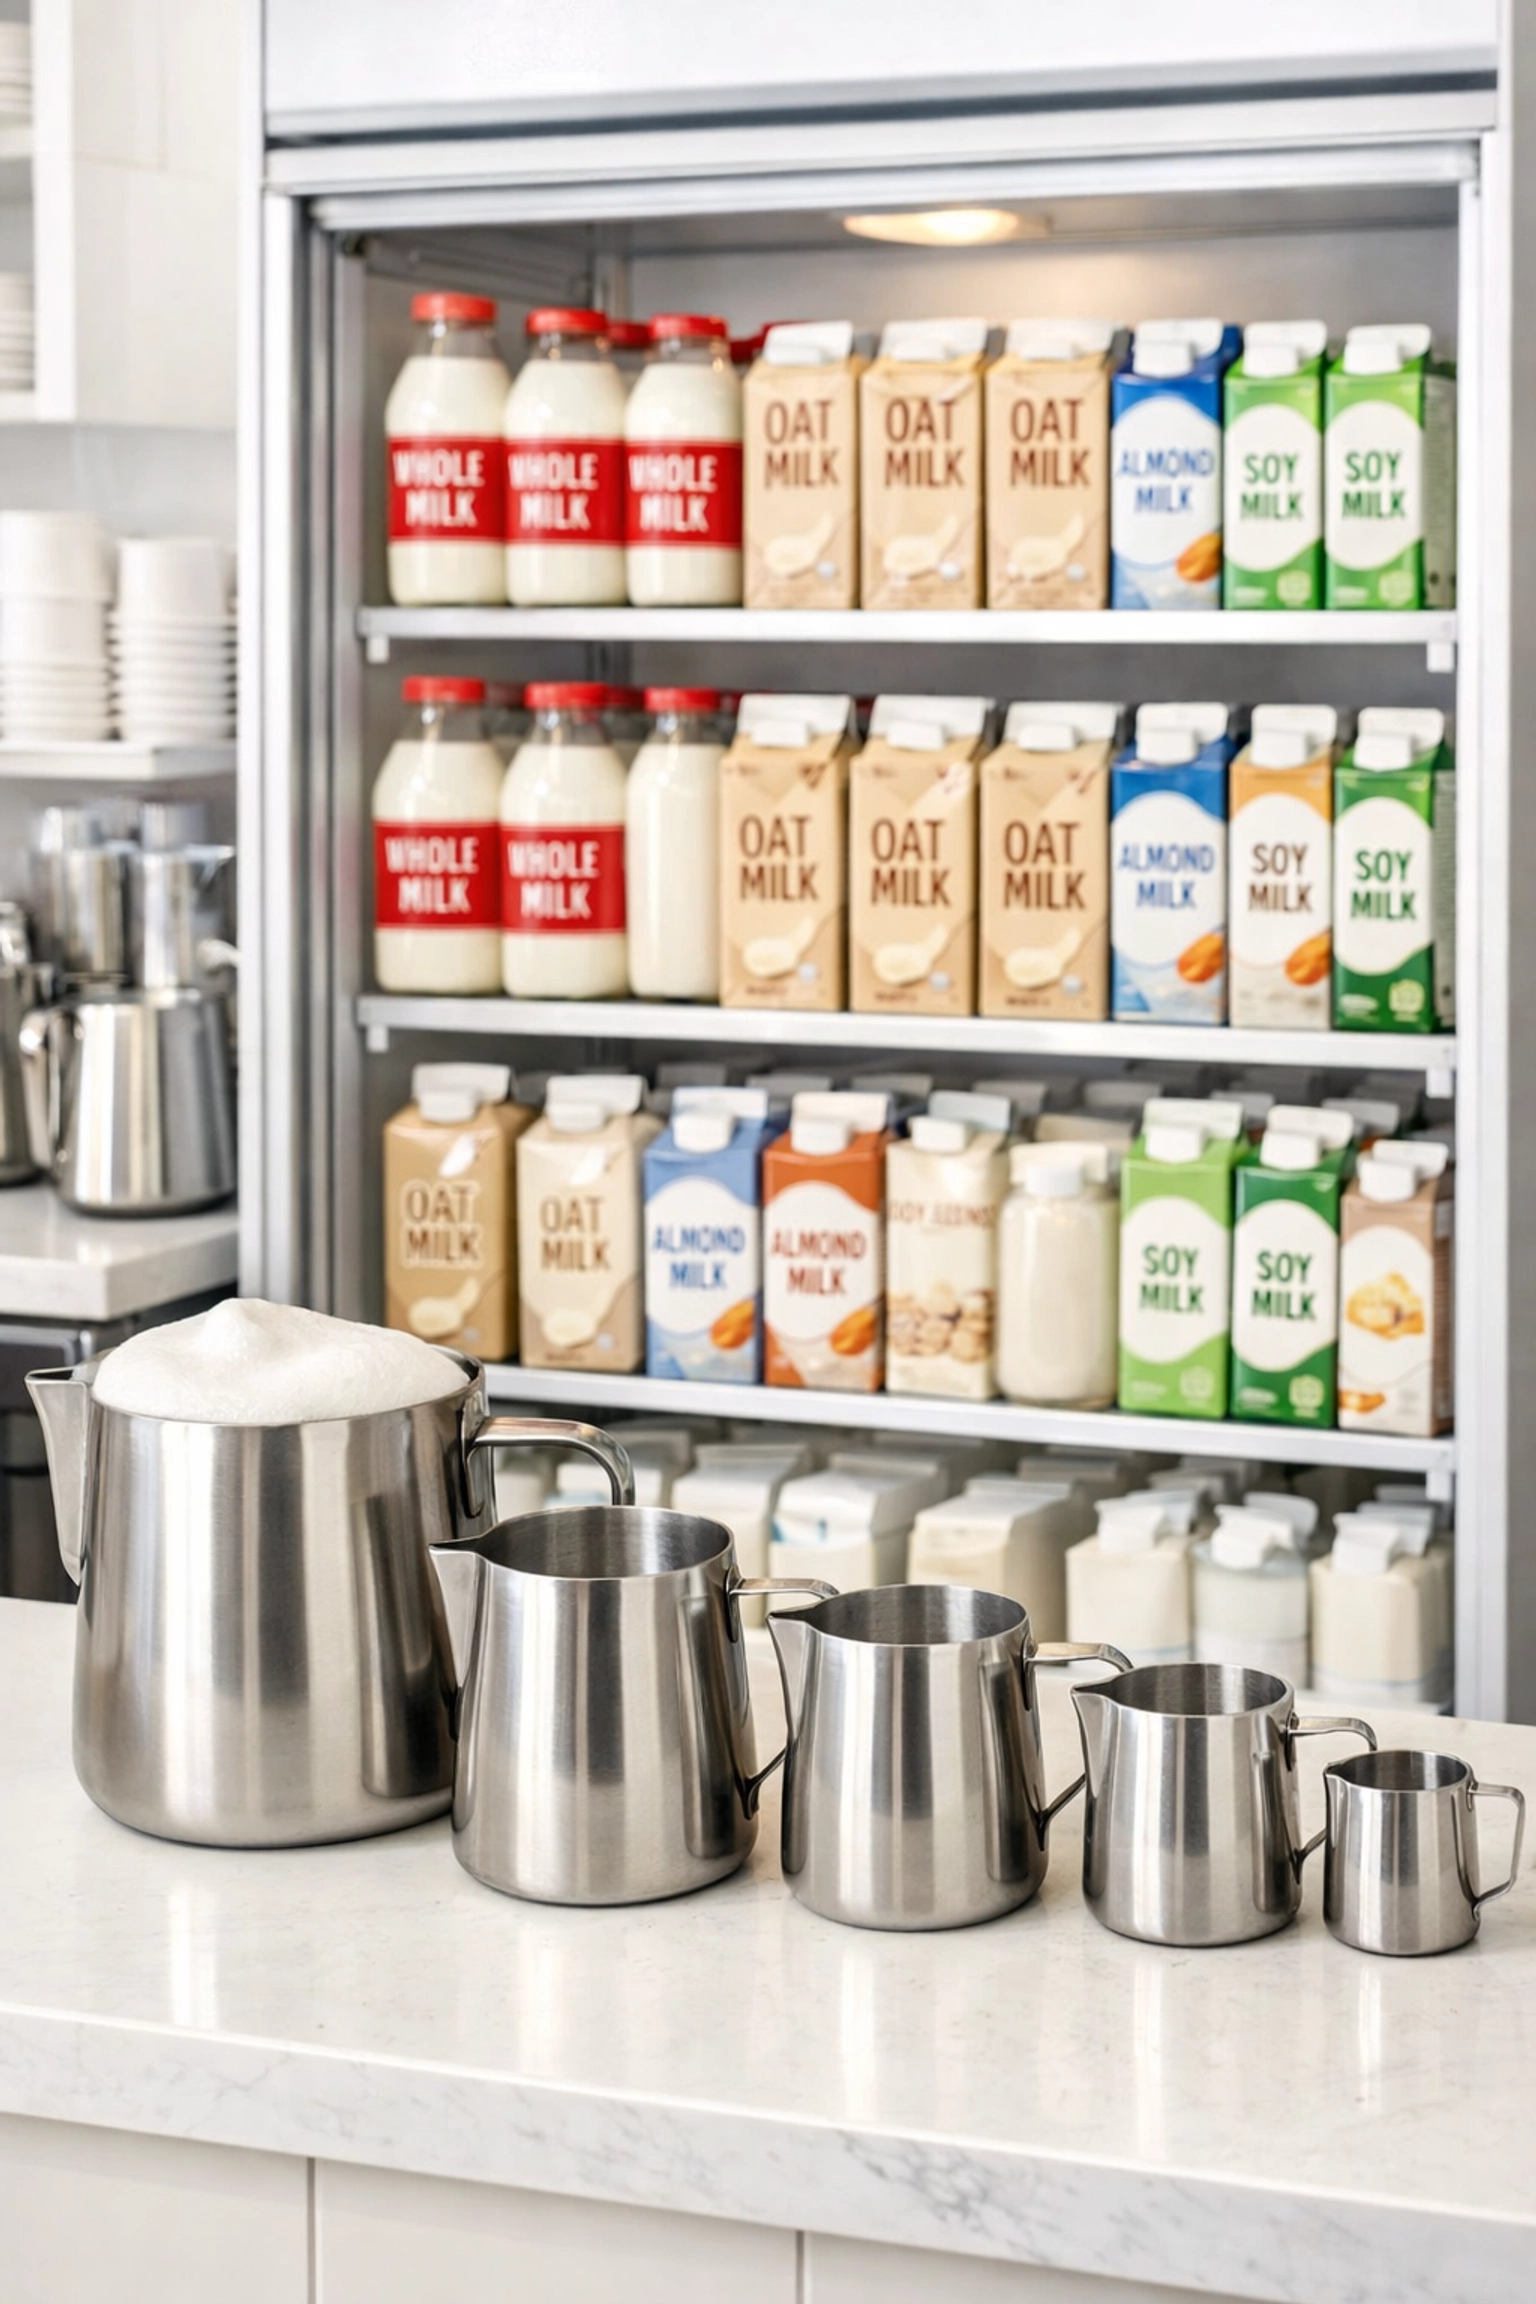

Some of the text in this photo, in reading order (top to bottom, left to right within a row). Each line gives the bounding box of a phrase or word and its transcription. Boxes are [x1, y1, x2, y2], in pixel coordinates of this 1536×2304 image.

[765, 400, 831, 444] OAT
[885, 399, 957, 442] OAT
[1011, 399, 1082, 442] OAT
[393, 449, 485, 487] WHOLE
[508, 452, 598, 490] WHOLE
[629, 455, 717, 492] WHOLE
[765, 451, 839, 489] MILK
[885, 451, 964, 488] MILK
[1011, 451, 1090, 488] MILK
[1117, 450, 1214, 477] ALMOND
[1245, 455, 1298, 483] SOY
[1346, 452, 1400, 483] SOY
[405, 489, 477, 527] MILK
[520, 492, 591, 530] MILK
[640, 494, 708, 532] MILK
[1134, 486, 1192, 513] MILK
[1240, 494, 1303, 519] MILK
[1342, 491, 1405, 518] MILK
[385, 836, 479, 873] WHOLE
[740, 815, 810, 858] OAT
[871, 818, 944, 862] OAT
[1004, 821, 1079, 865] OAT
[507, 841, 599, 879] WHOLE
[1119, 844, 1214, 873] ALMOND
[1253, 844, 1308, 874] SOY
[1355, 850, 1412, 882] SOY
[398, 877, 471, 914] MILK
[521, 881, 591, 919] MILK
[740, 865, 818, 901] MILK
[871, 869, 951, 906] MILK
[1004, 872, 1085, 910] MILK
[1136, 882, 1196, 909] MILK
[1249, 884, 1312, 912] MILK
[1351, 891, 1416, 920] MILK
[404, 1184, 477, 1223] OAT
[540, 1198, 603, 1234] OAT
[406, 1228, 479, 1261] MILK
[541, 1239, 611, 1271] MILK
[654, 1225, 745, 1252] ALMOND
[772, 1230, 866, 1259] ALMOND
[668, 1262, 726, 1289] MILK
[1143, 1246, 1198, 1276] SOY
[1257, 1251, 1312, 1283] SOY
[787, 1266, 845, 1295] MILK
[1139, 1284, 1204, 1313] MILK
[1251, 1291, 1316, 1320] MILK
